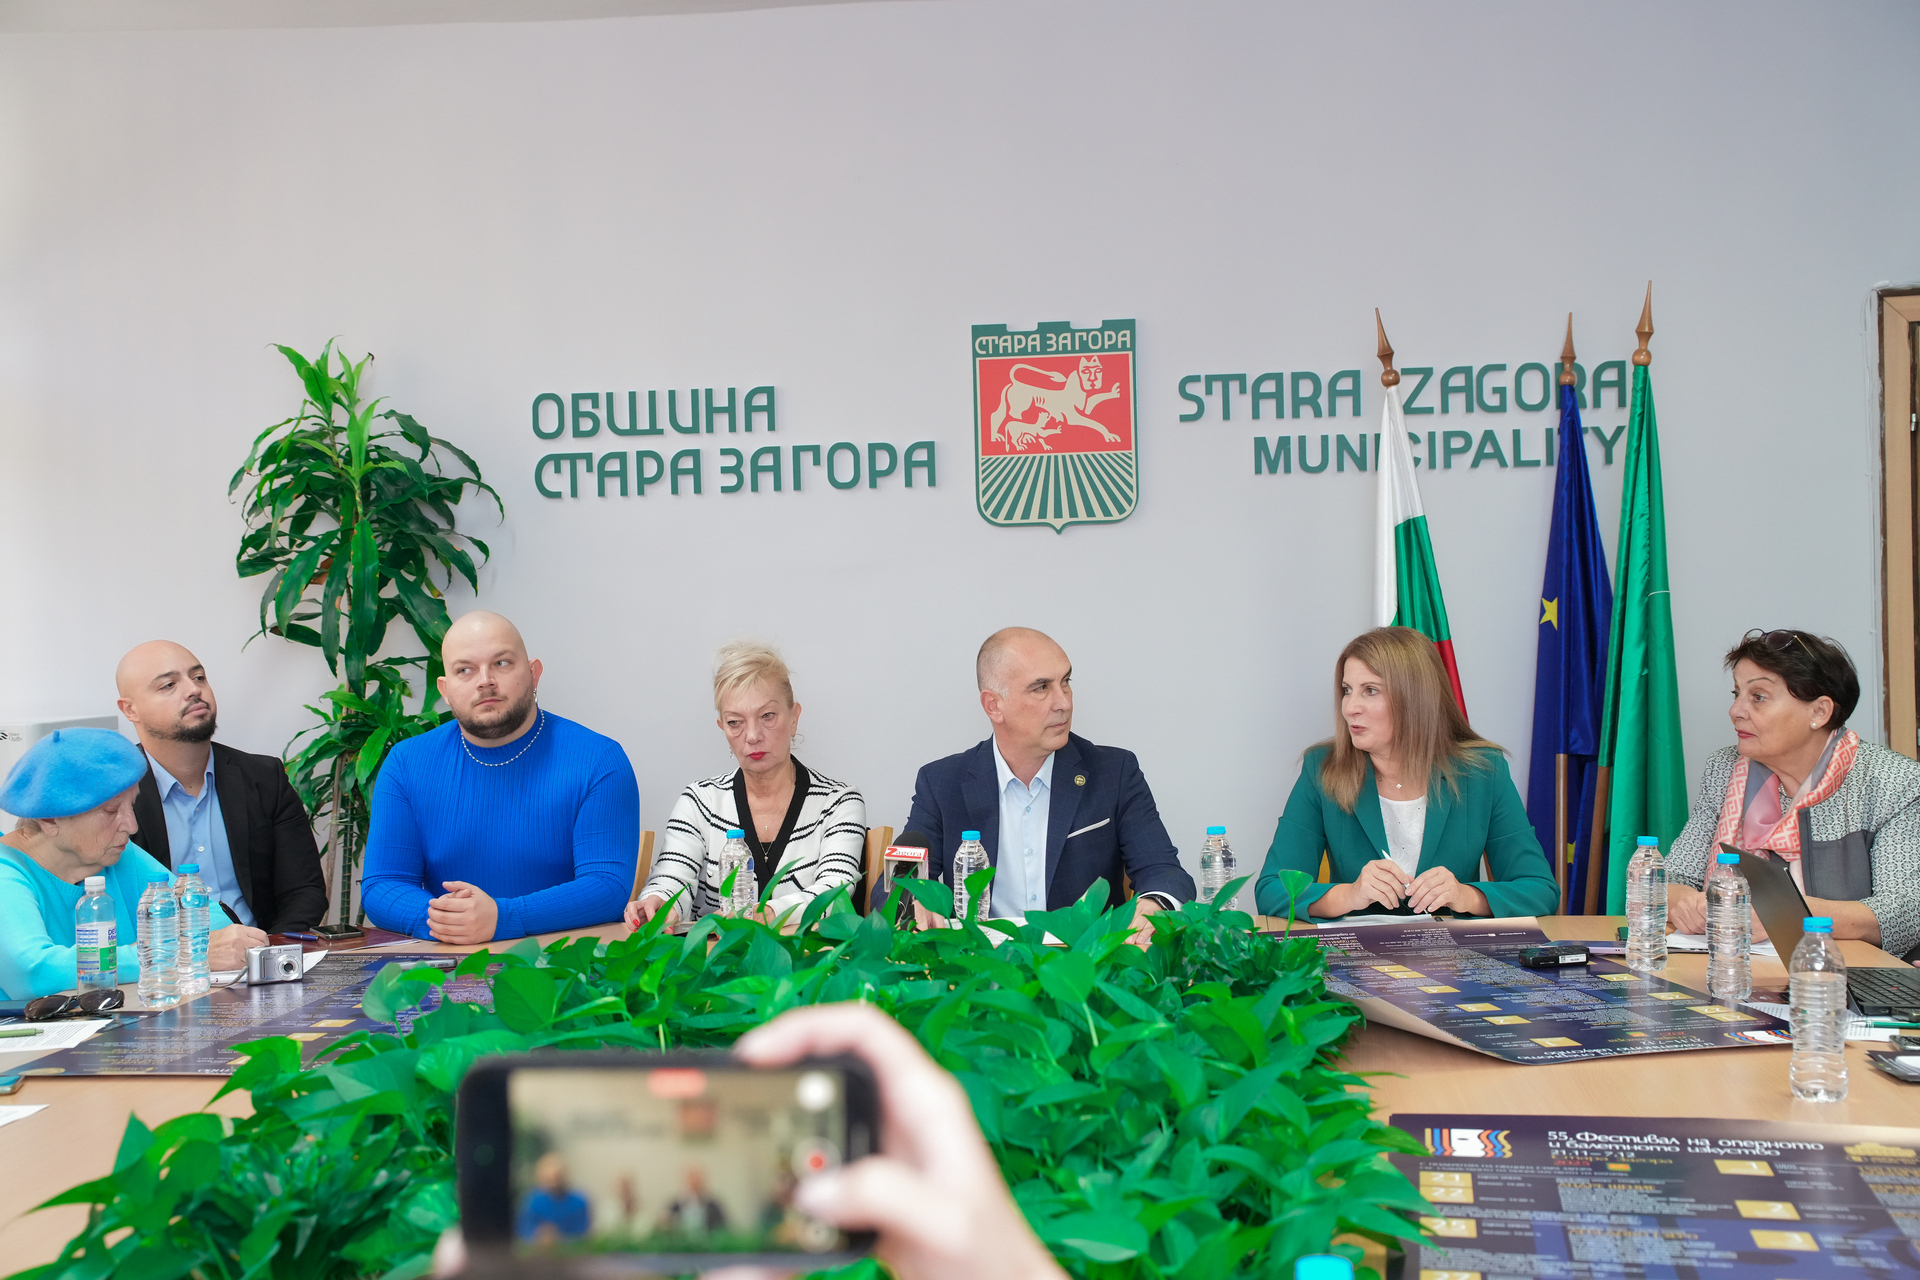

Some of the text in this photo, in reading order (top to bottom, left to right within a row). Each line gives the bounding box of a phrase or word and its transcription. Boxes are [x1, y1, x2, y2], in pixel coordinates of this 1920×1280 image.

[975, 330, 1131, 355] СТАРА ЗАГОРА
[532, 385, 776, 440] ОБЩИНА
[1178, 370, 1361, 422] STARA
[1253, 425, 1626, 475] MUNIIPALIY
[534, 440, 937, 499] СТАРА ЗАГОРА
[885, 847, 922, 859] Zagora
[1547, 1131, 1824, 1151] 55. Фестивал на оперното
[1565, 1140, 1680, 1152] балетното
[1687, 1146, 1781, 1156] изкуство
